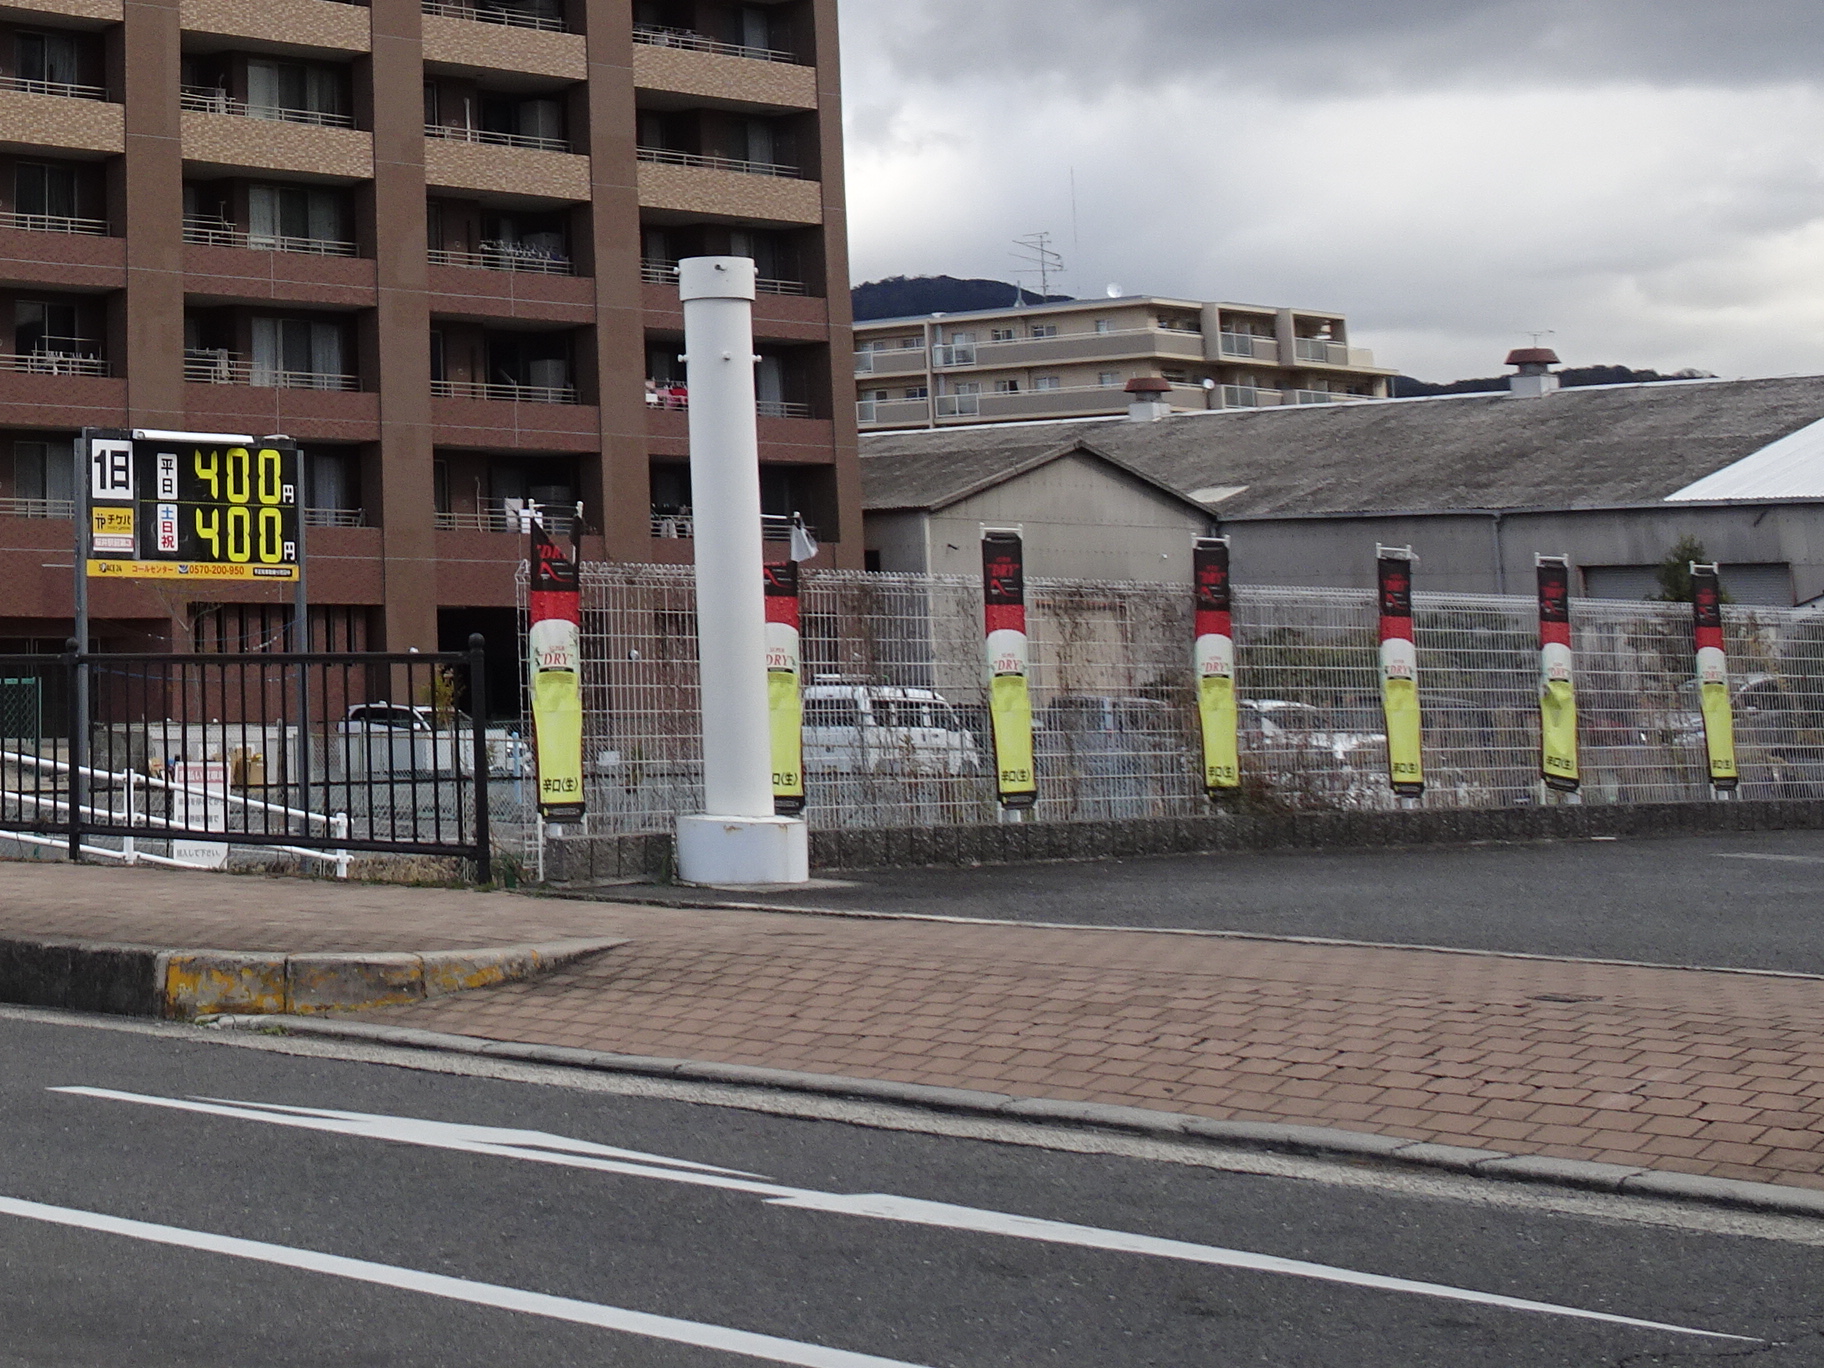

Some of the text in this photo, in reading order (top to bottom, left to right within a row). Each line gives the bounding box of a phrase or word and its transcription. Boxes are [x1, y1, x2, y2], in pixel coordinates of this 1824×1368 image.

[94, 449, 130, 490] 1日
[160, 458, 174, 494] 平日
[161, 506, 175, 549] 土日祝
[132, 565, 174, 574] コールセンター
[189, 565, 244, 575] 0570-200-950
